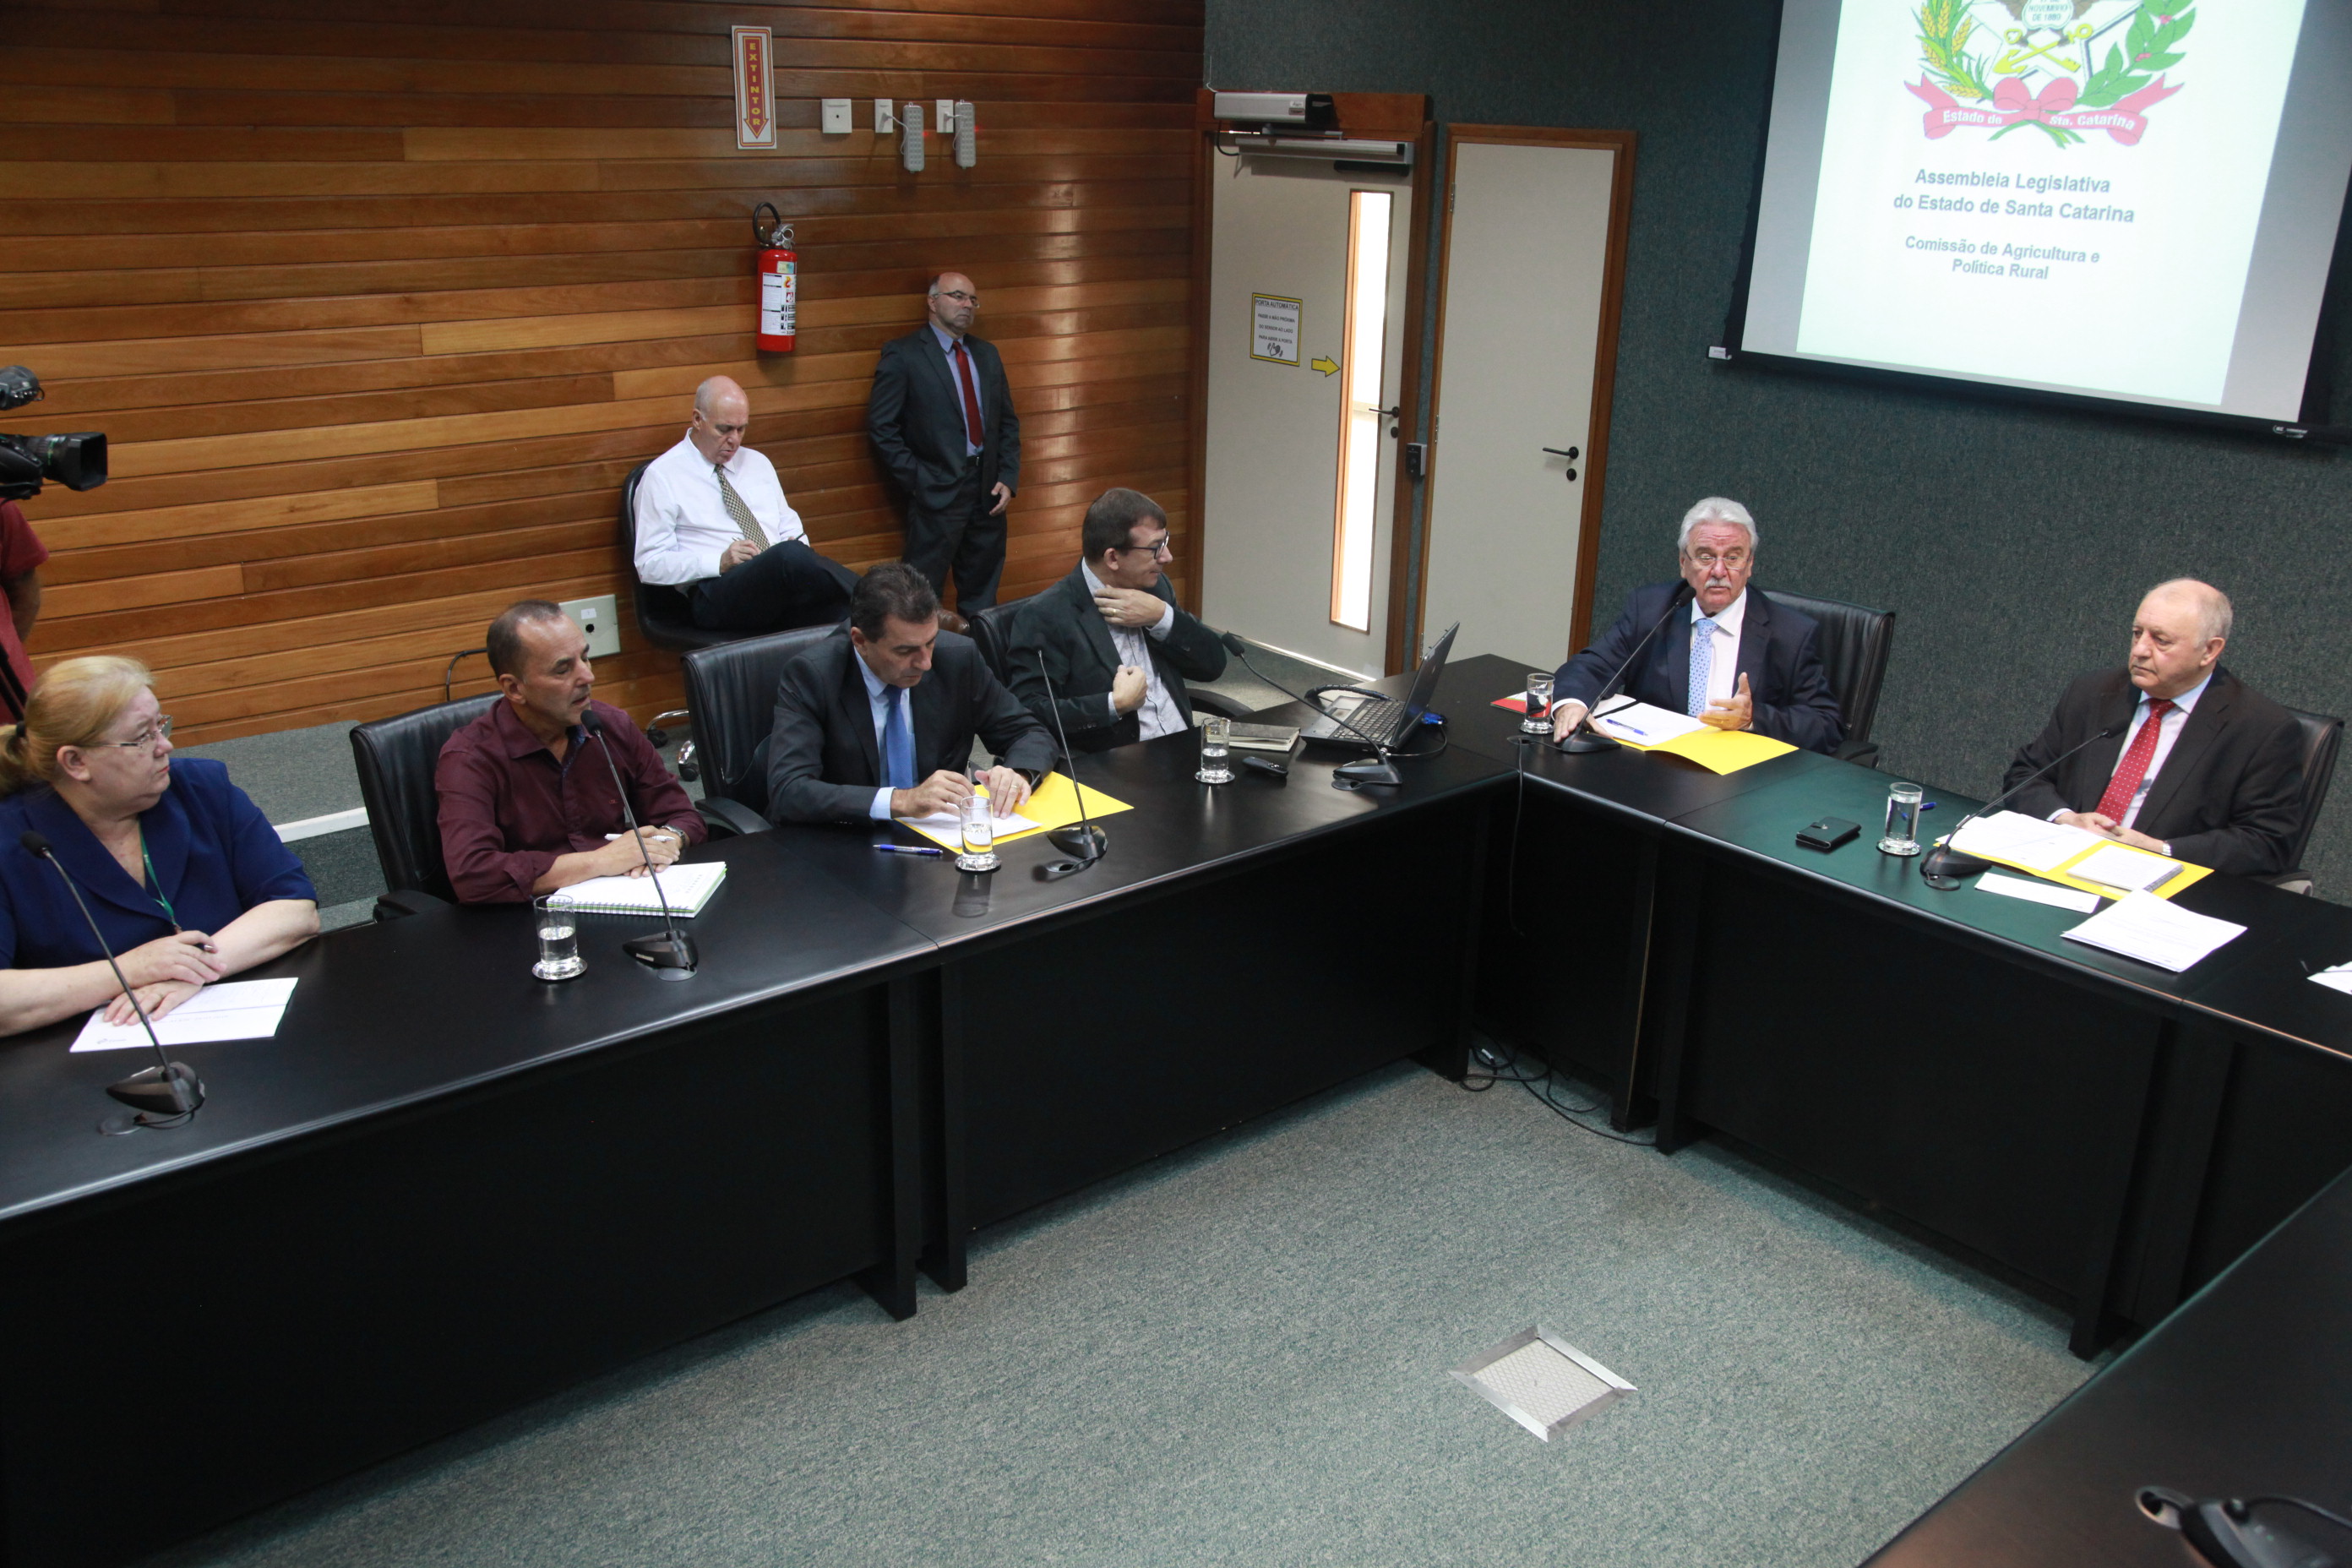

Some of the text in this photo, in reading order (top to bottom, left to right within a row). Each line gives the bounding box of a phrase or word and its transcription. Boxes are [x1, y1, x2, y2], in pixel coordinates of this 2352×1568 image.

[749, 42, 761, 126] EXTINTOR
[1943, 110, 1984, 123] Estado
[1987, 112, 2002, 124] de
[2077, 114, 2135, 130] Catarina
[1915, 168, 2110, 194] Assembleia Legislativa
[1893, 193, 2135, 223] do Estado de Santa Catarina
[1905, 235, 2100, 263] Comissão de Agricultura e
[1952, 258, 2049, 280] Política Rural
